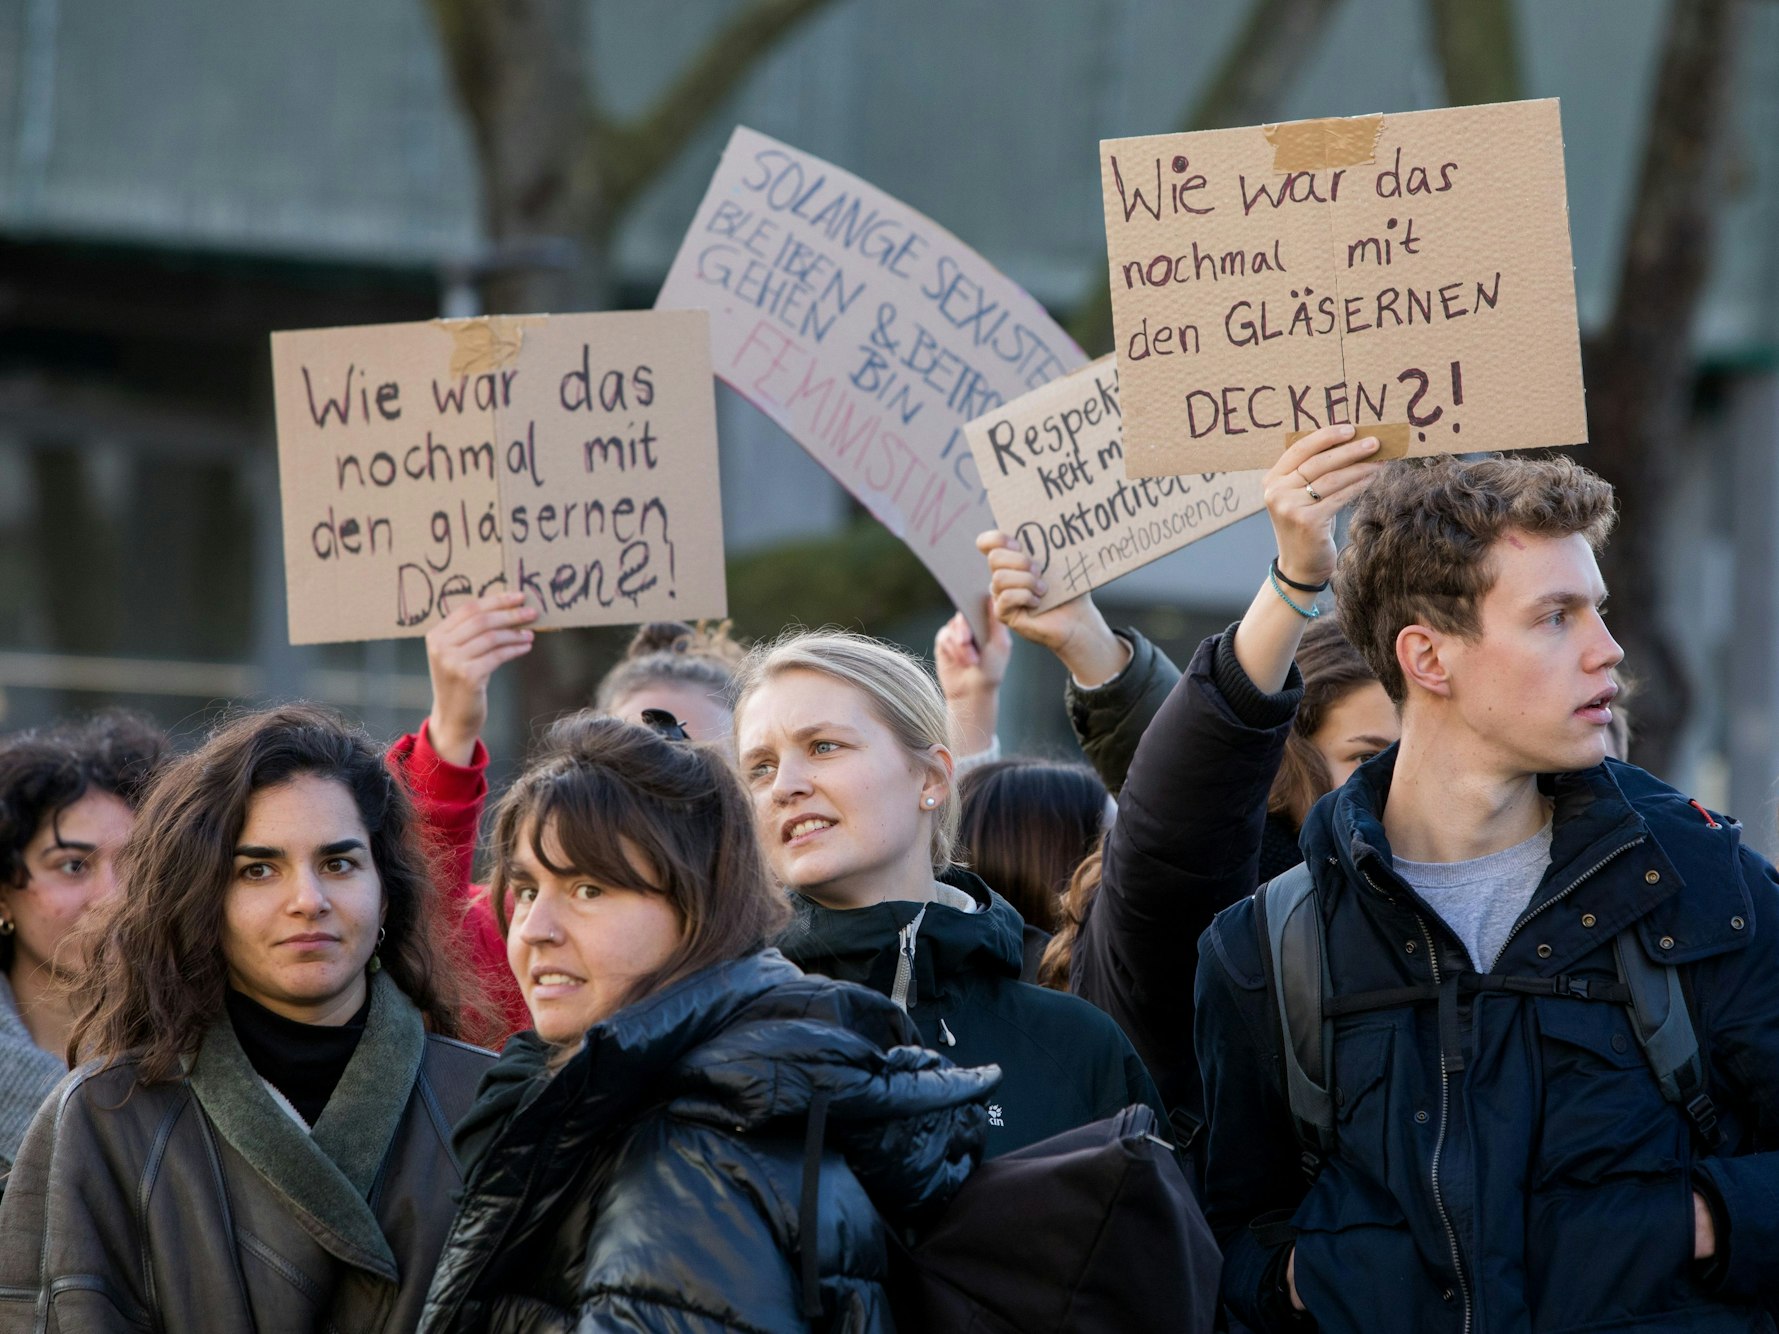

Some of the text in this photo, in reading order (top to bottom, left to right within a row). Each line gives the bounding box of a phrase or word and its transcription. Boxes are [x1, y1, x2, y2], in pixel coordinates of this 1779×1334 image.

[1111, 147, 1459, 222] Wie war das
[706, 200, 867, 315] BLEIBEN
[869, 302, 900, 356] &
[742, 149, 1068, 389] SOLANGE SEXISTE
[1122, 218, 1421, 289] nochmal mit
[1128, 273, 1501, 361] den GLÄSERNEN
[302, 343, 656, 429] Wie war das
[698, 243, 987, 505] GEHEN BIN IC
[1186, 361, 1464, 442] DECKEN?!
[337, 420, 657, 490] nochmal mit
[1037, 452, 1094, 500] keit
[312, 505, 393, 560] den
[988, 1117, 1005, 1127] kin
